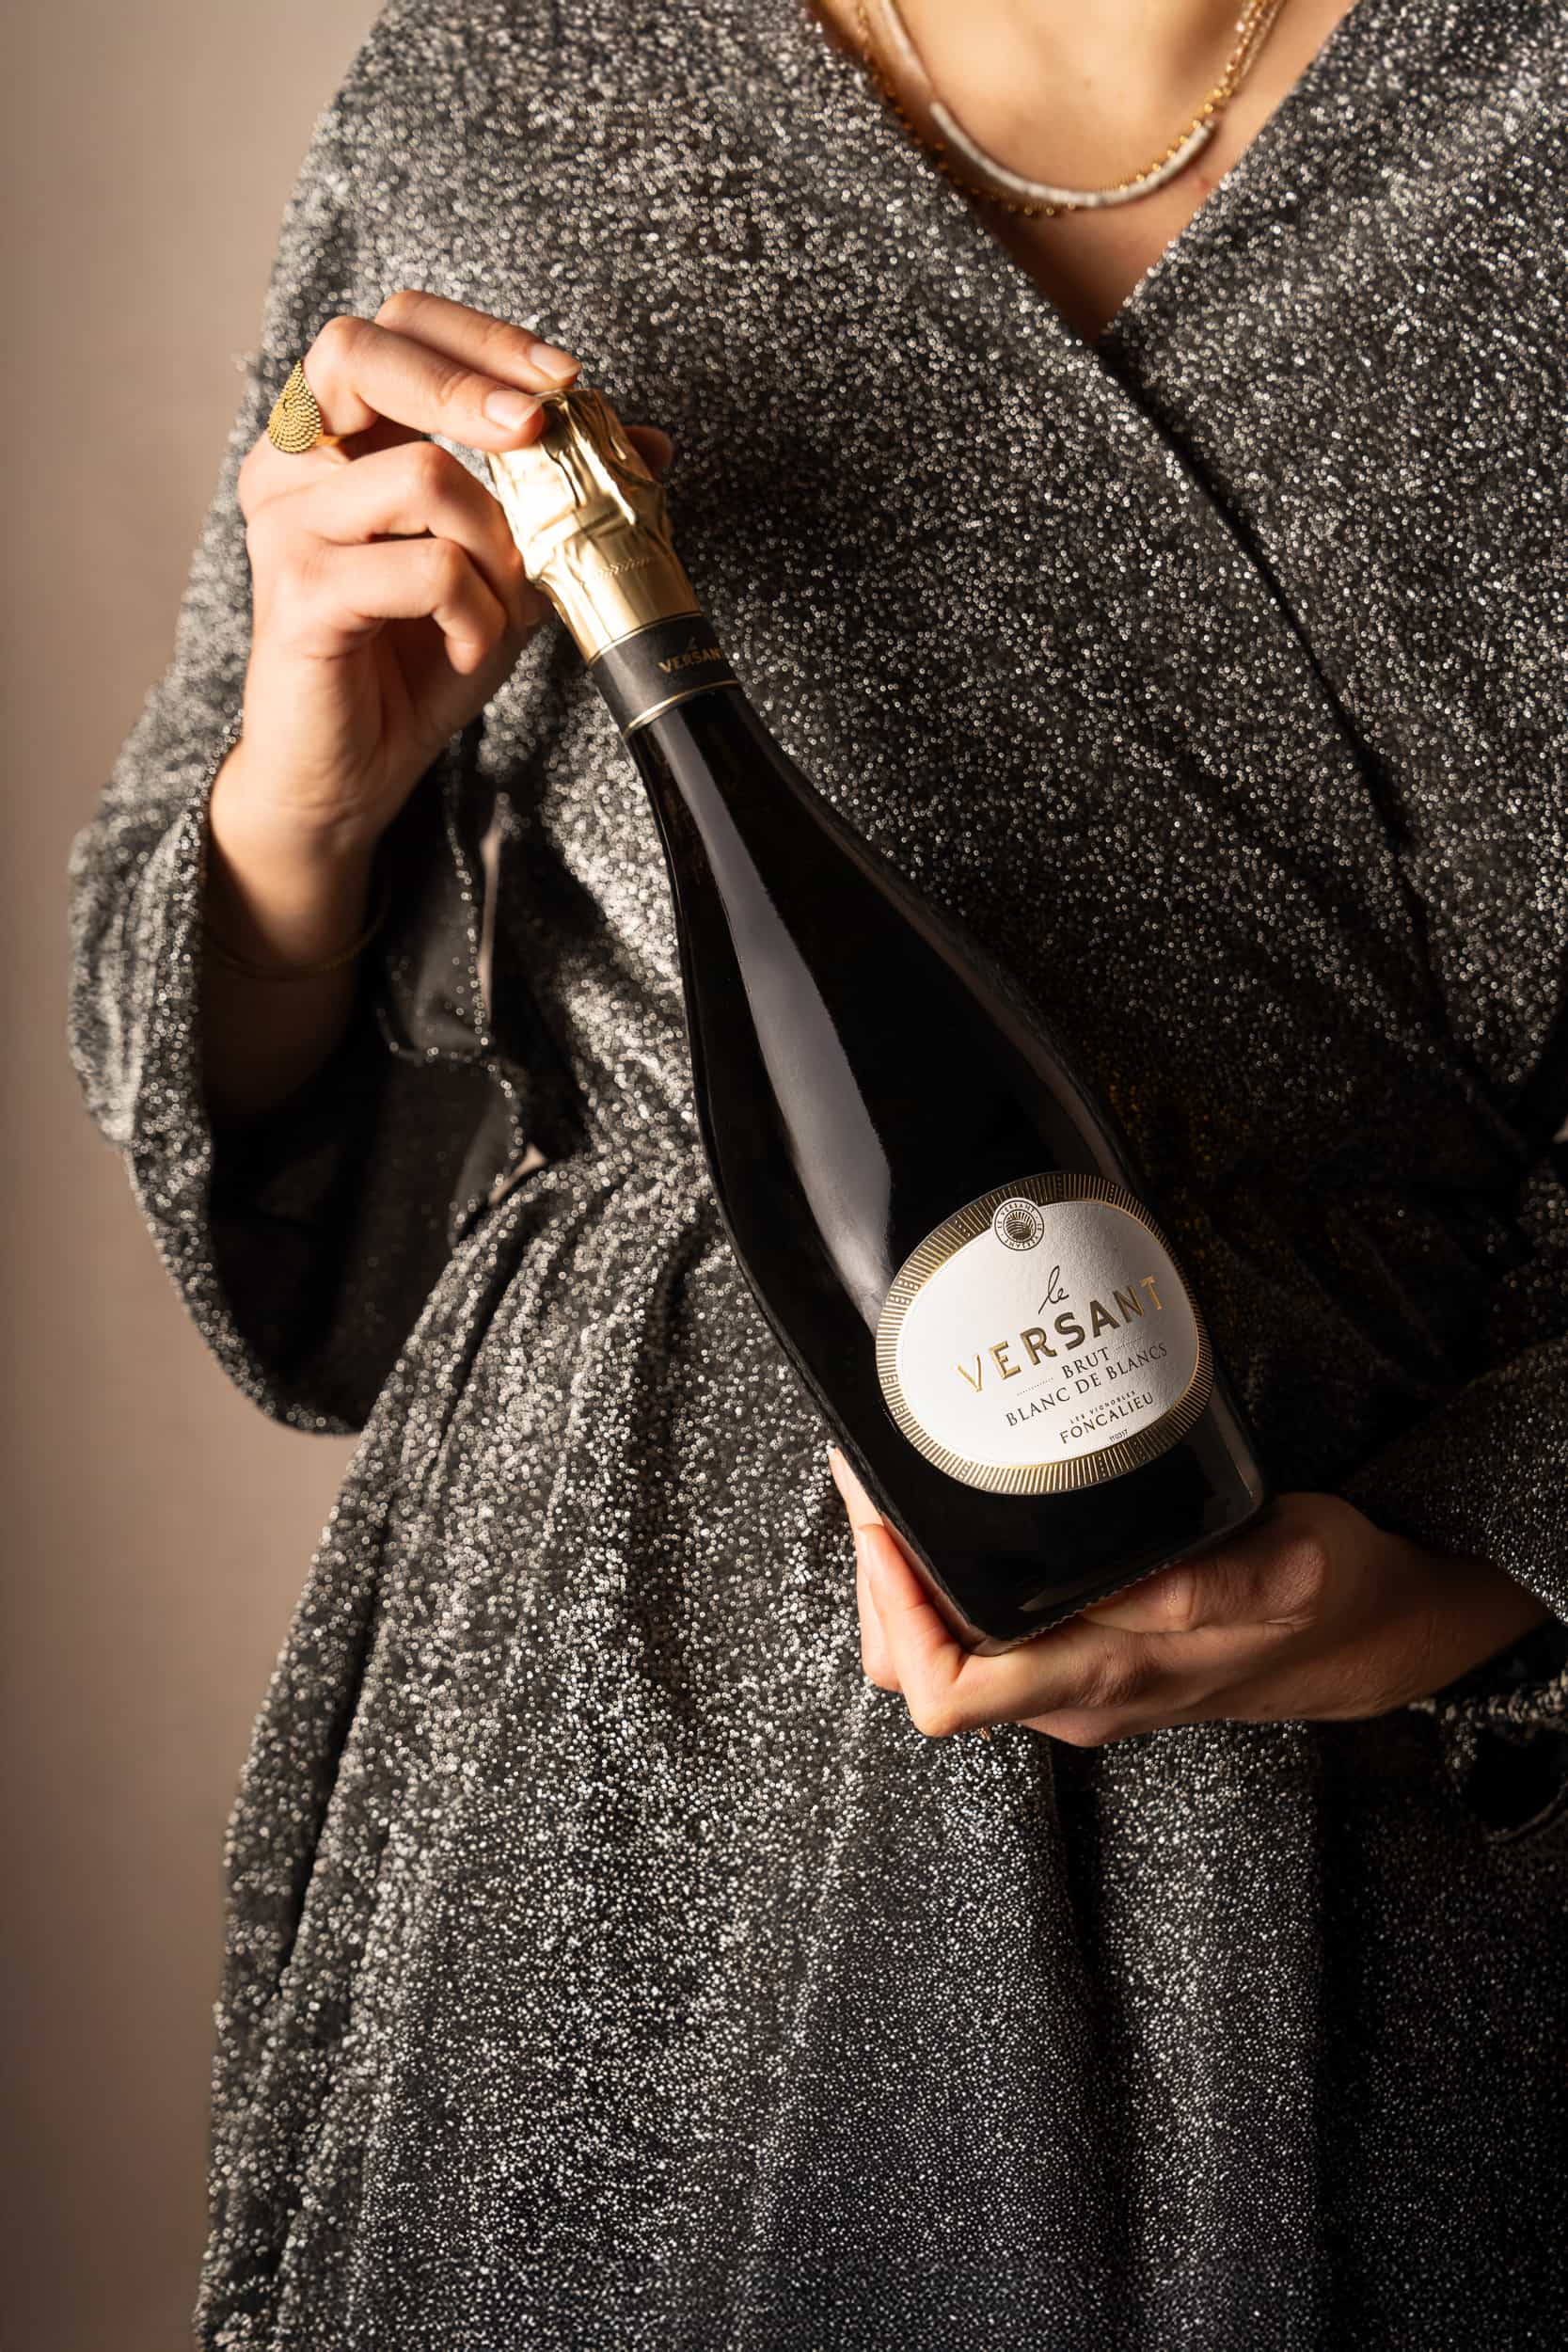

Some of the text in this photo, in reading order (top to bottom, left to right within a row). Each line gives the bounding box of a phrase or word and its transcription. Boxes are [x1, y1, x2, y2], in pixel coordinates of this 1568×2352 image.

[1038, 1264, 1069, 1315] le
[957, 1275, 1164, 1393] VERSANT
[1006, 1342, 1168, 1427] BLANC DE BLANCS
[1061, 1346, 1111, 1379] BRUT
[1059, 1391, 1154, 1444] FONCALIEU
[1069, 1390, 1136, 1424] LES VIGNOBLES
